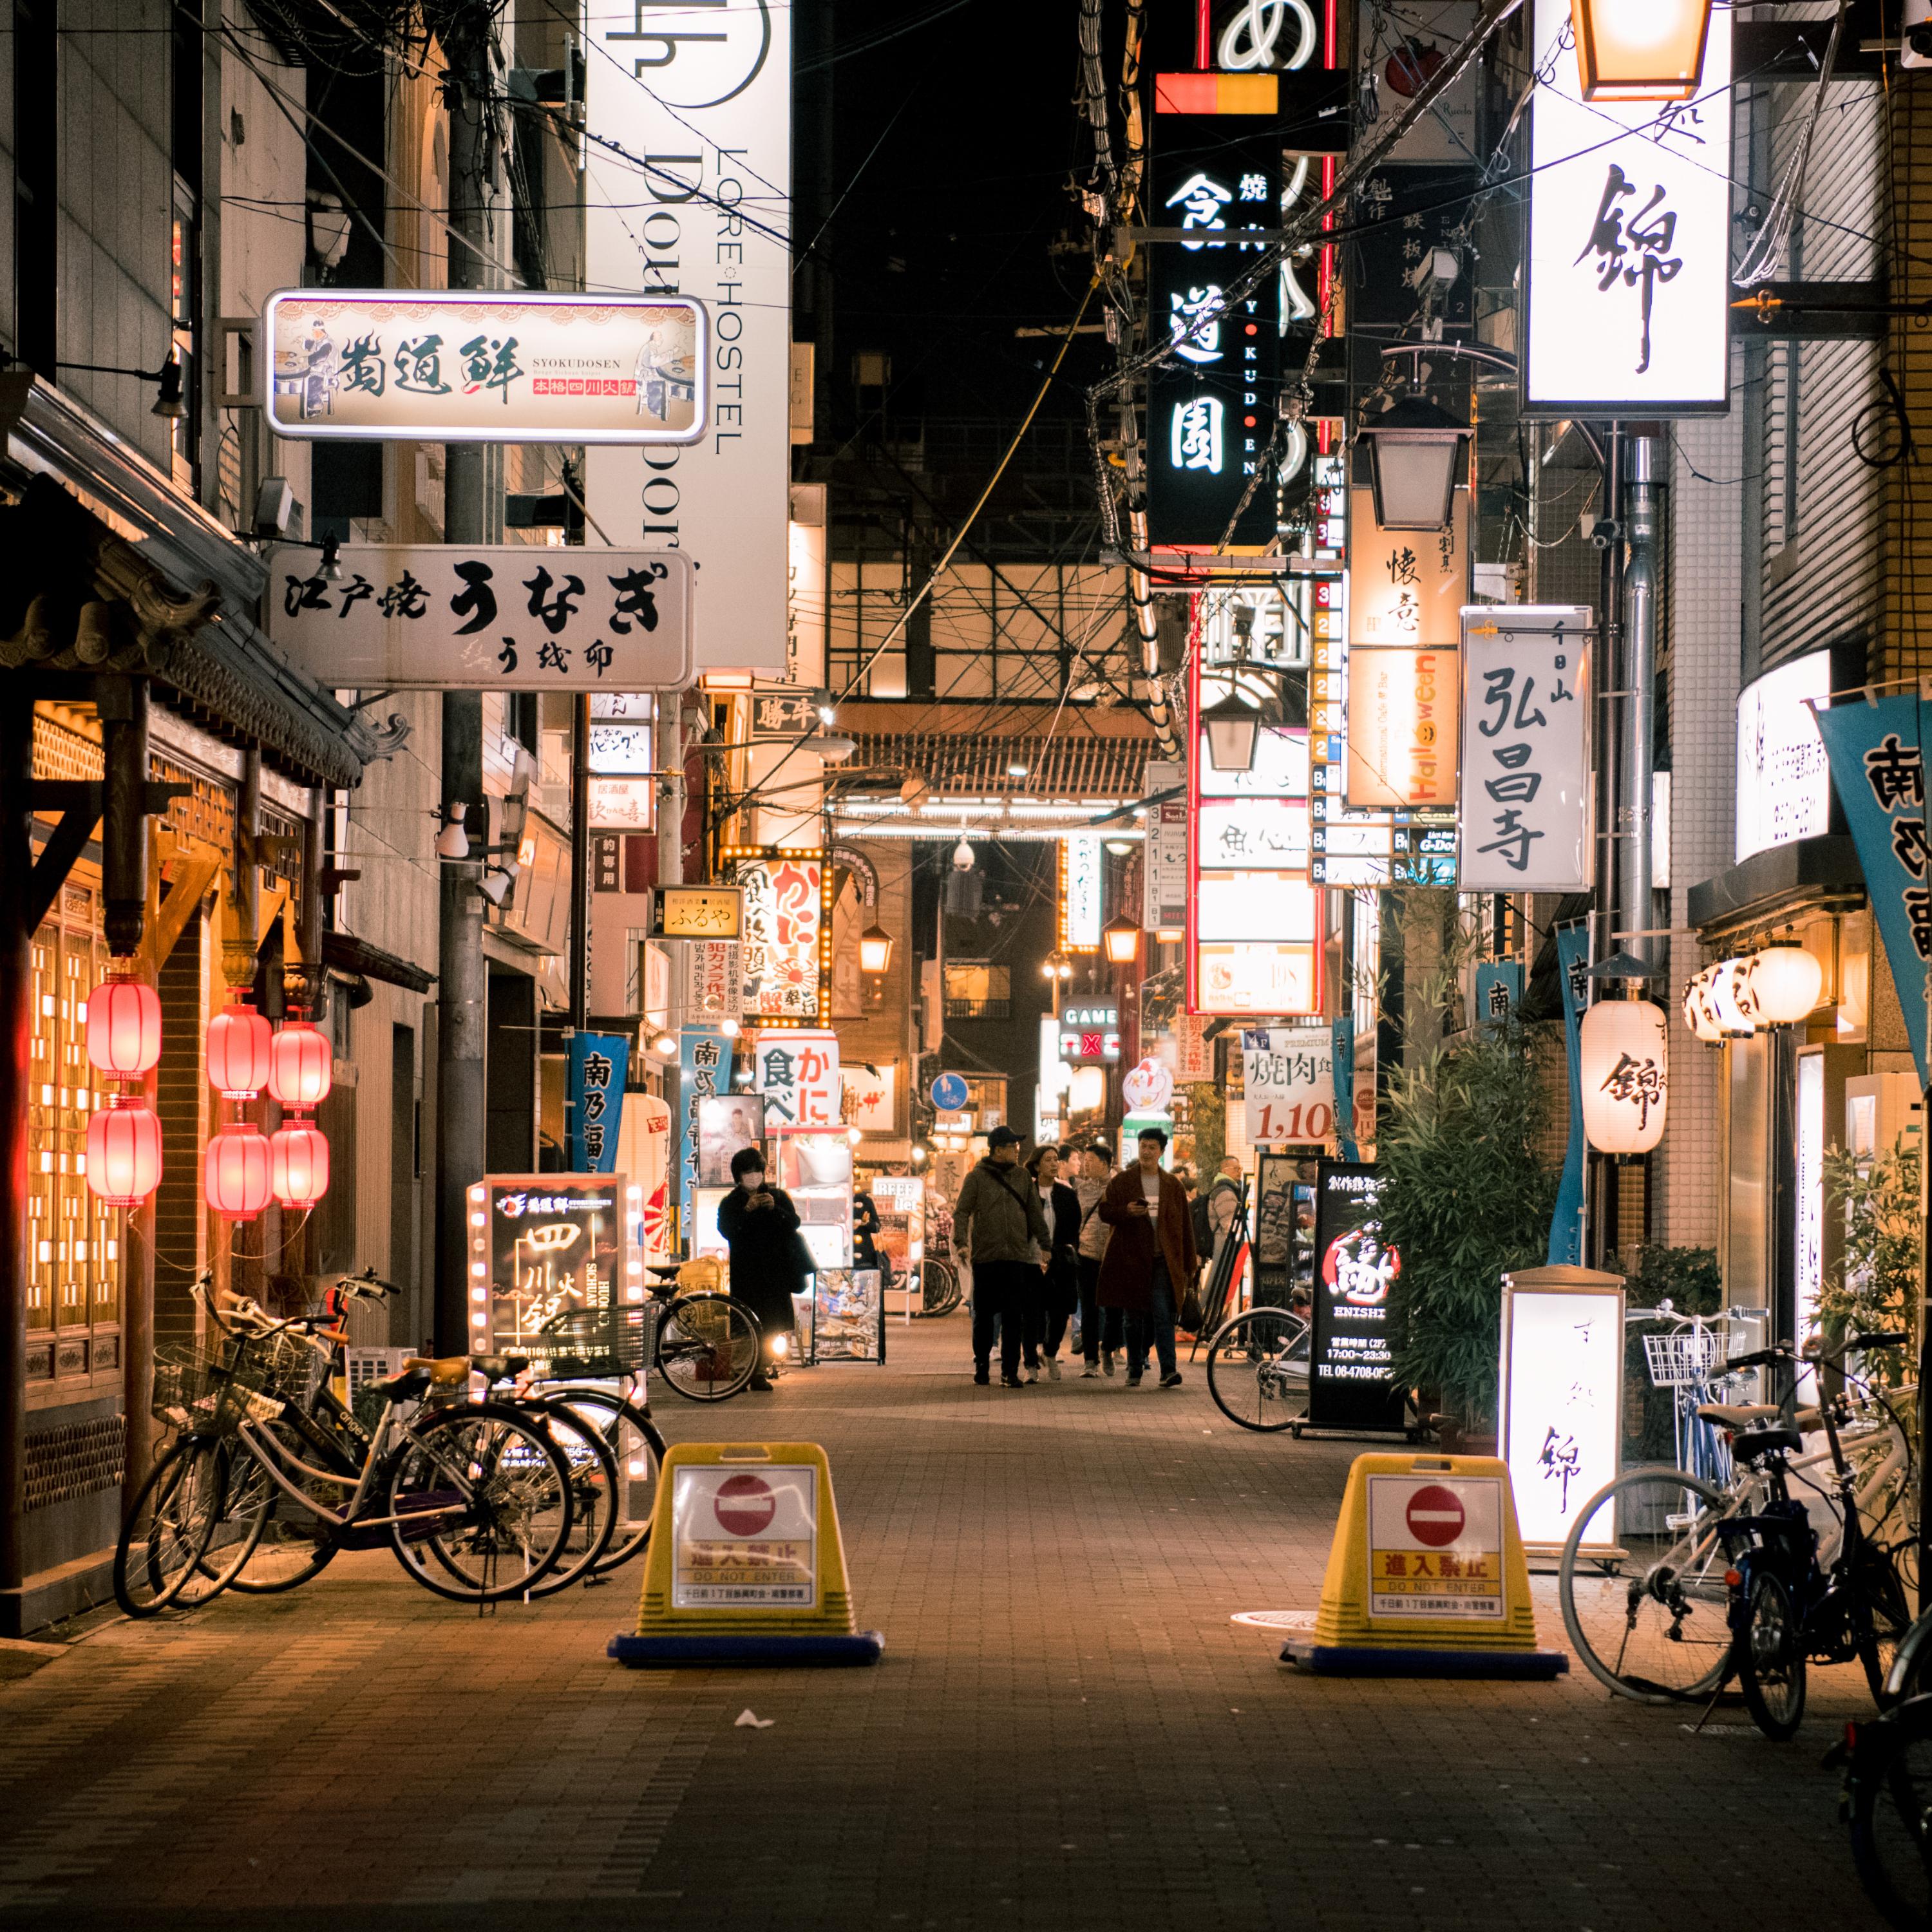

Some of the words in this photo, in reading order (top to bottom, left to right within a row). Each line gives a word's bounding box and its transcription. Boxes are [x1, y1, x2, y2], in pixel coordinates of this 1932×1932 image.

[716, 149, 748, 265] LORE
[1573, 164, 1683, 374] 錦
[341, 329, 525, 404] 蜀道鮮
[533, 358, 621, 368] SYOKUDOSEN
[716, 283, 744, 455] HOSTEL
[1318, 524, 1327, 540] 3
[1318, 587, 1329, 603] 3
[1318, 617, 1329, 633] 2
[1317, 648, 1328, 664] 2
[1316, 679, 1327, 695] 2
[757, 696, 816, 730] 勝牛
[1316, 709, 1327, 725] 2
[1316, 741, 1327, 756] 2
[1477, 668, 1546, 871] 弘昌寺
[598, 784, 629, 795] 居酒屋
[1151, 807, 1159, 819] 3
[1151, 828, 1159, 840] 2
[1152, 848, 1158, 860] 1
[1152, 868, 1158, 881] 1
[773, 862, 820, 945] かに
[671, 908, 730, 928] ふるや
[706, 942, 726, 1010] 犯カメラ作
[1065, 1009, 1117, 1025] GAME
[1249, 1034, 1268, 1048] 4F
[1284, 1038, 1330, 1048] PREMIUM
[763, 1048, 796, 1121] 食べ
[798, 1047, 829, 1122] かに
[1599, 1052, 1660, 1131] 錦
[1255, 1103, 1359, 1139] 1,10
[586, 1263, 597, 1307] SICHUAN
[1334, 1306, 1387, 1318] ENISHI
[1318, 1365, 1334, 1376] TEL
[1334, 1365, 1396, 1379] 06-4708-0
[1537, 1426, 1581, 1514] 錦
[691, 1544, 797, 1567] 進入禁止
[1385, 1553, 1488, 1578] 進入禁止
[694, 1572, 712, 1581] DO
[720, 1572, 745, 1581] NOT
[754, 1572, 795, 1581] ENTER
[1388, 1582, 1406, 1591] DO
[1414, 1582, 1439, 1592] NOT
[1446, 1582, 1486, 1593] ENTER
